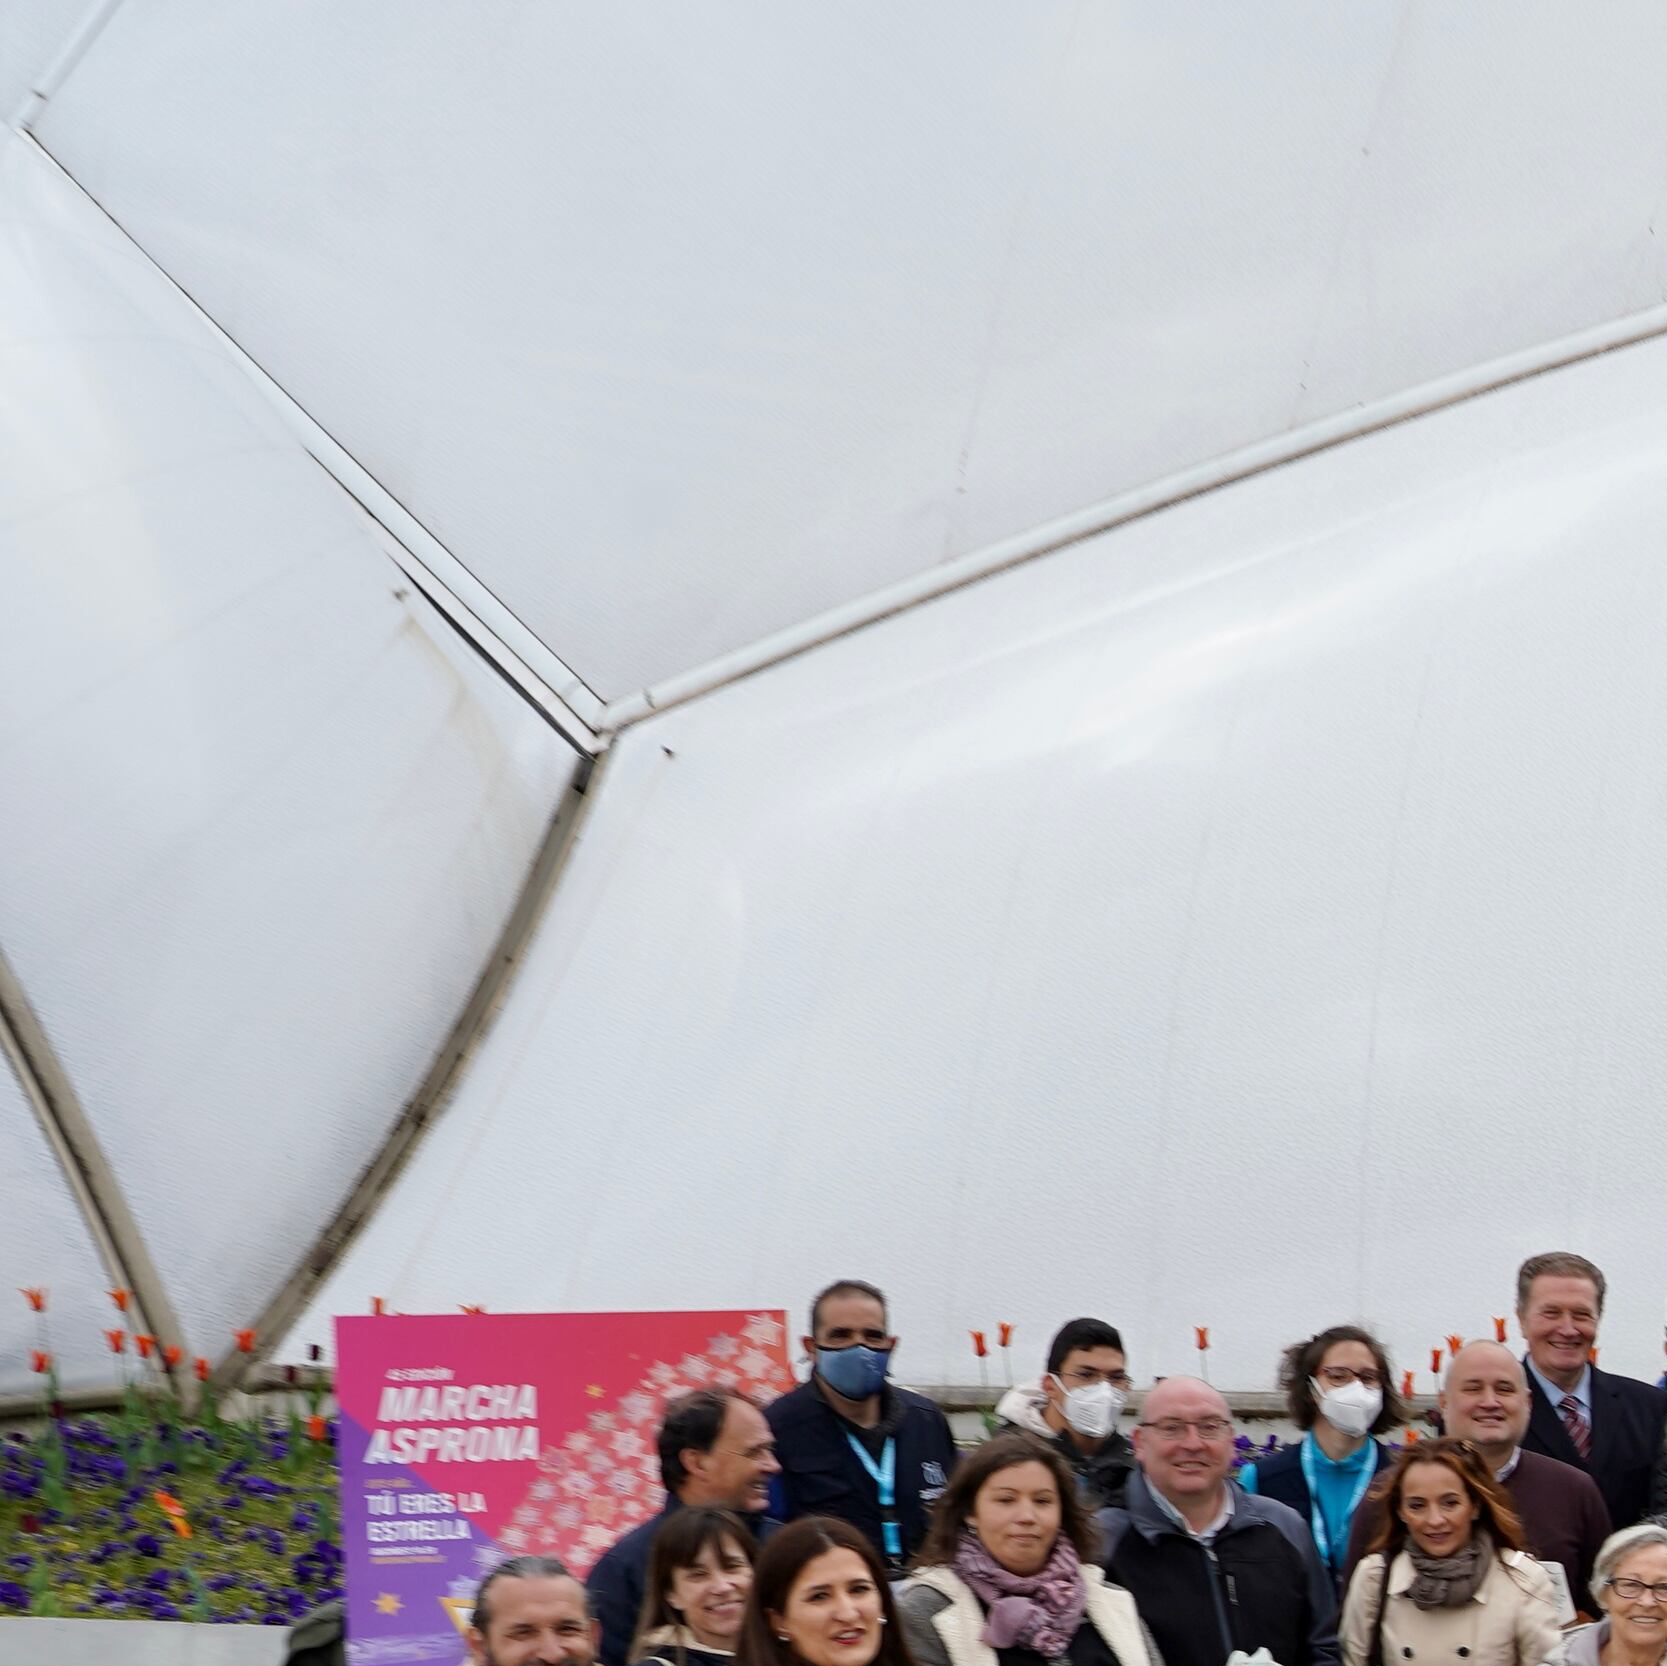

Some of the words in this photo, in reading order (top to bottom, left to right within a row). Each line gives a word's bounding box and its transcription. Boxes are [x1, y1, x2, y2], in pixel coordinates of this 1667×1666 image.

[376, 1384, 538, 1422] MARCHA
[362, 1426, 540, 1464] ASPRONA
[398, 1492, 457, 1515] ERES
[457, 1492, 488, 1513] LA
[366, 1519, 472, 1542] ESTRELLA
